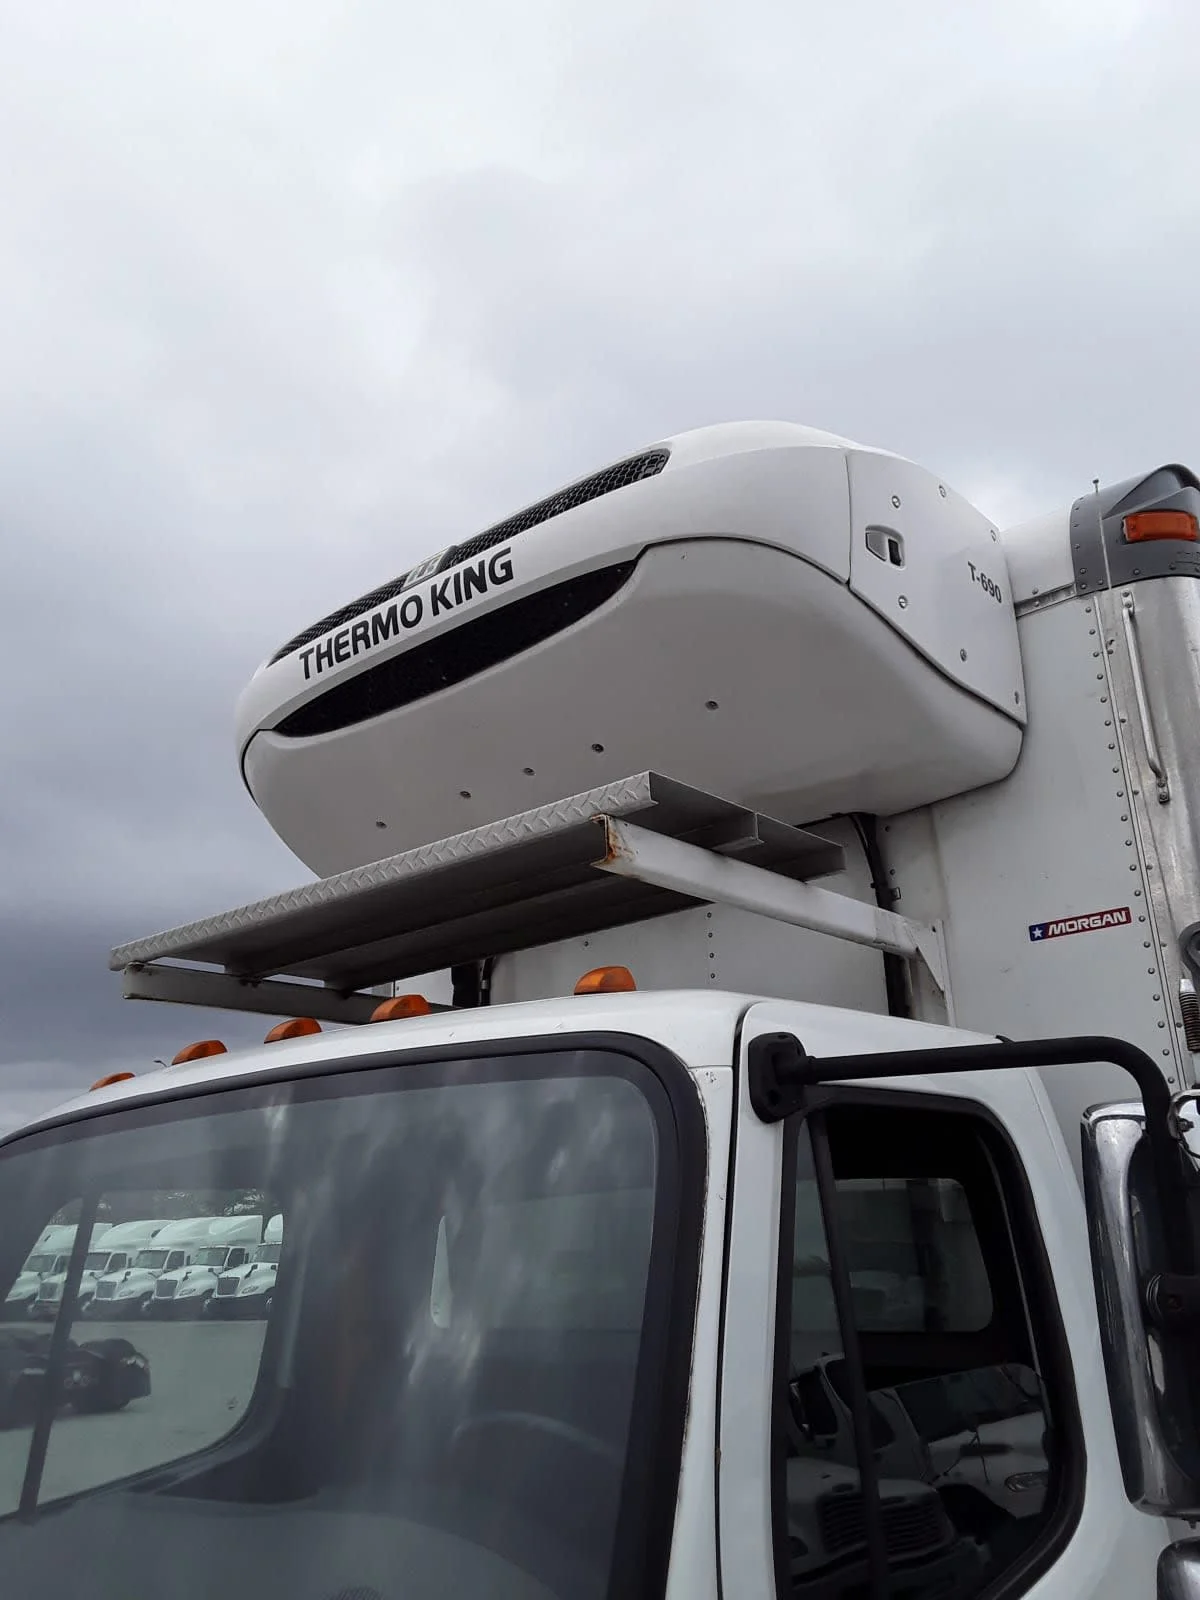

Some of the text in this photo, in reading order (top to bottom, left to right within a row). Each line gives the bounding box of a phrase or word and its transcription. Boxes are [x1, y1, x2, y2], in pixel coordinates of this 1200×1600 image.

[968, 560, 1002, 604] T-690
[299, 547, 514, 680] THERMO KING
[1048, 910, 1128, 936] MORGAN
